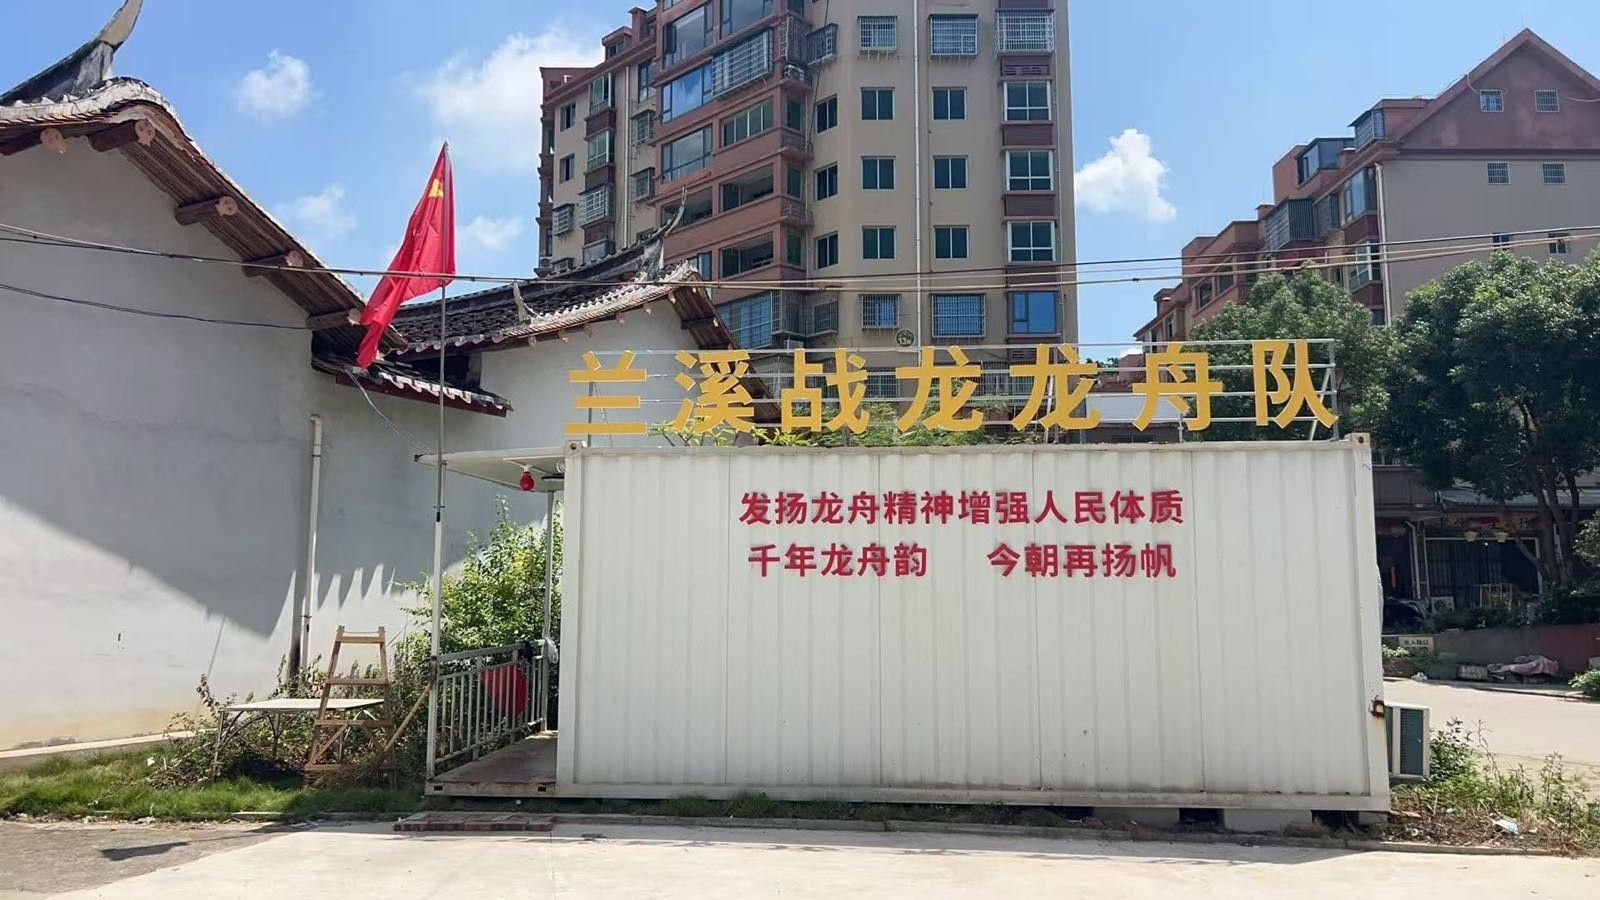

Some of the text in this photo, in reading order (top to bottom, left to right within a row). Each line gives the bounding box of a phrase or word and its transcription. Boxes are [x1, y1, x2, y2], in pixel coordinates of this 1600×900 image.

[566, 338, 1338, 435] 兰溪战龙龙舟队
[739, 490, 1184, 526] 发扬龙舟精神增强人民体质
[748, 543, 1177, 578] 千年龙舟韵 今朝再扬帆
